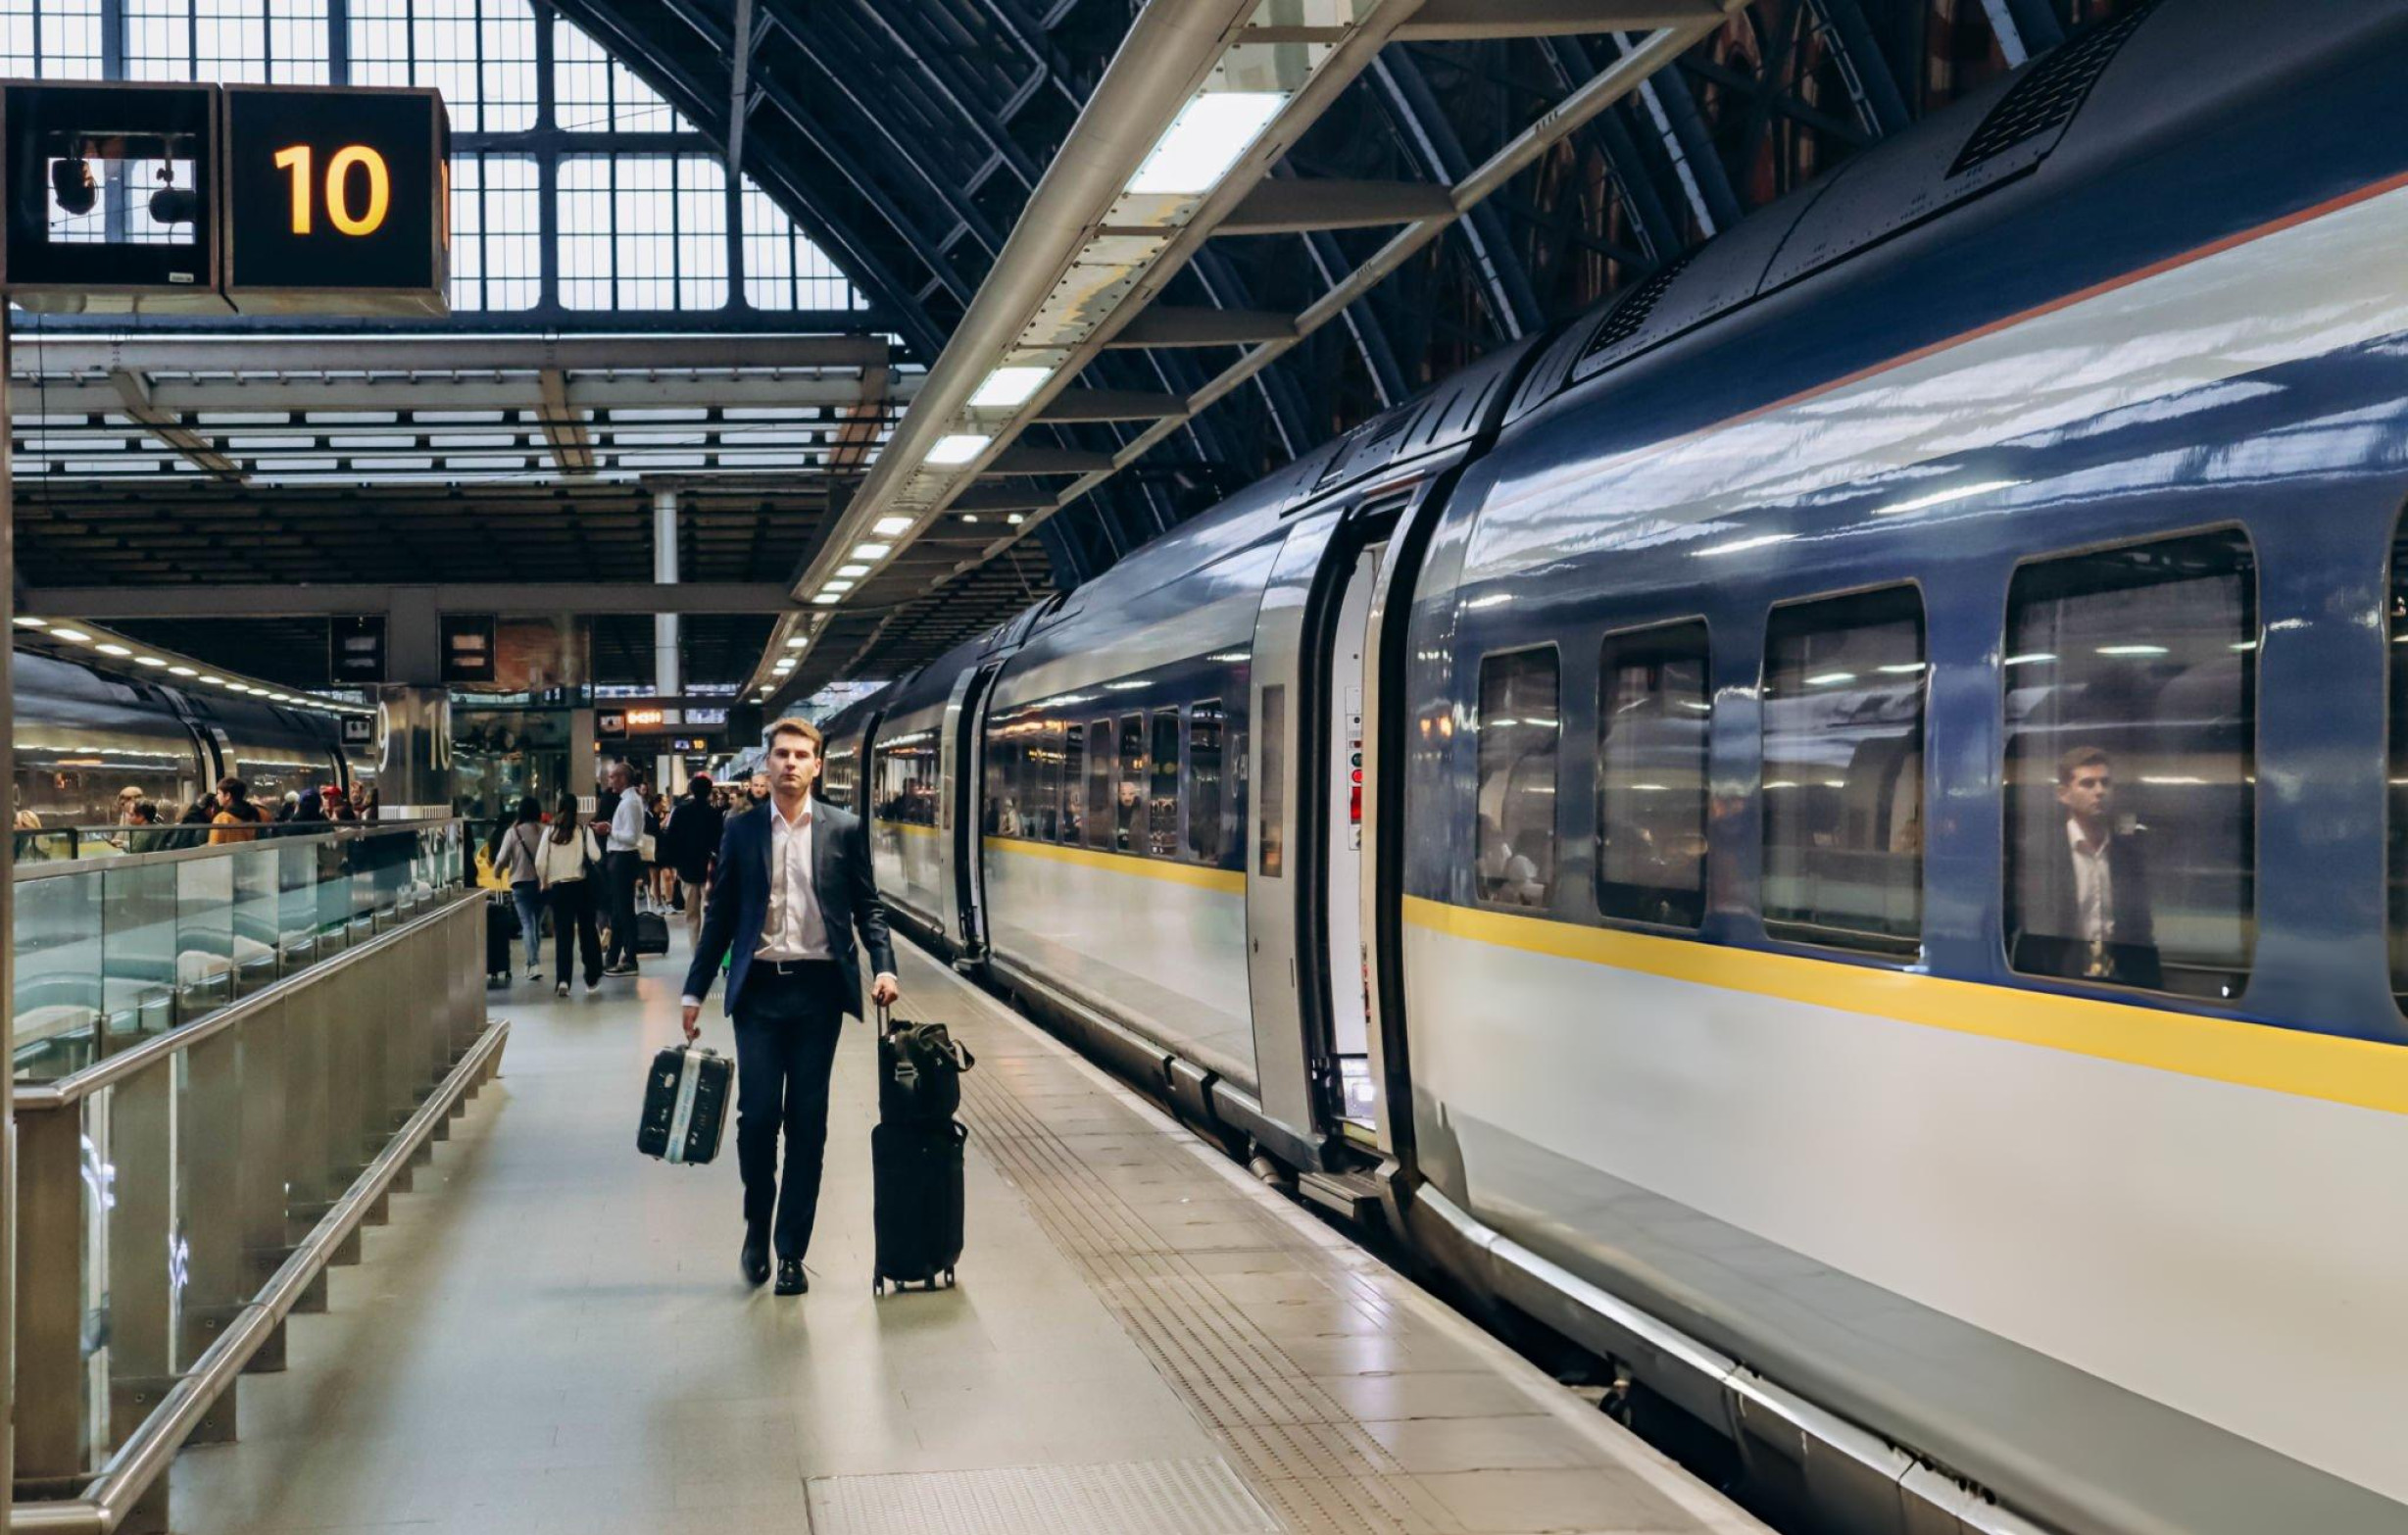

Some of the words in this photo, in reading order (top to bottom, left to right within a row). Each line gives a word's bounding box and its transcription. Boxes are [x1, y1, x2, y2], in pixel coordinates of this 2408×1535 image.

[274, 145, 389, 235] 10
[377, 700, 390, 773] 9
[424, 700, 452, 771] 10
